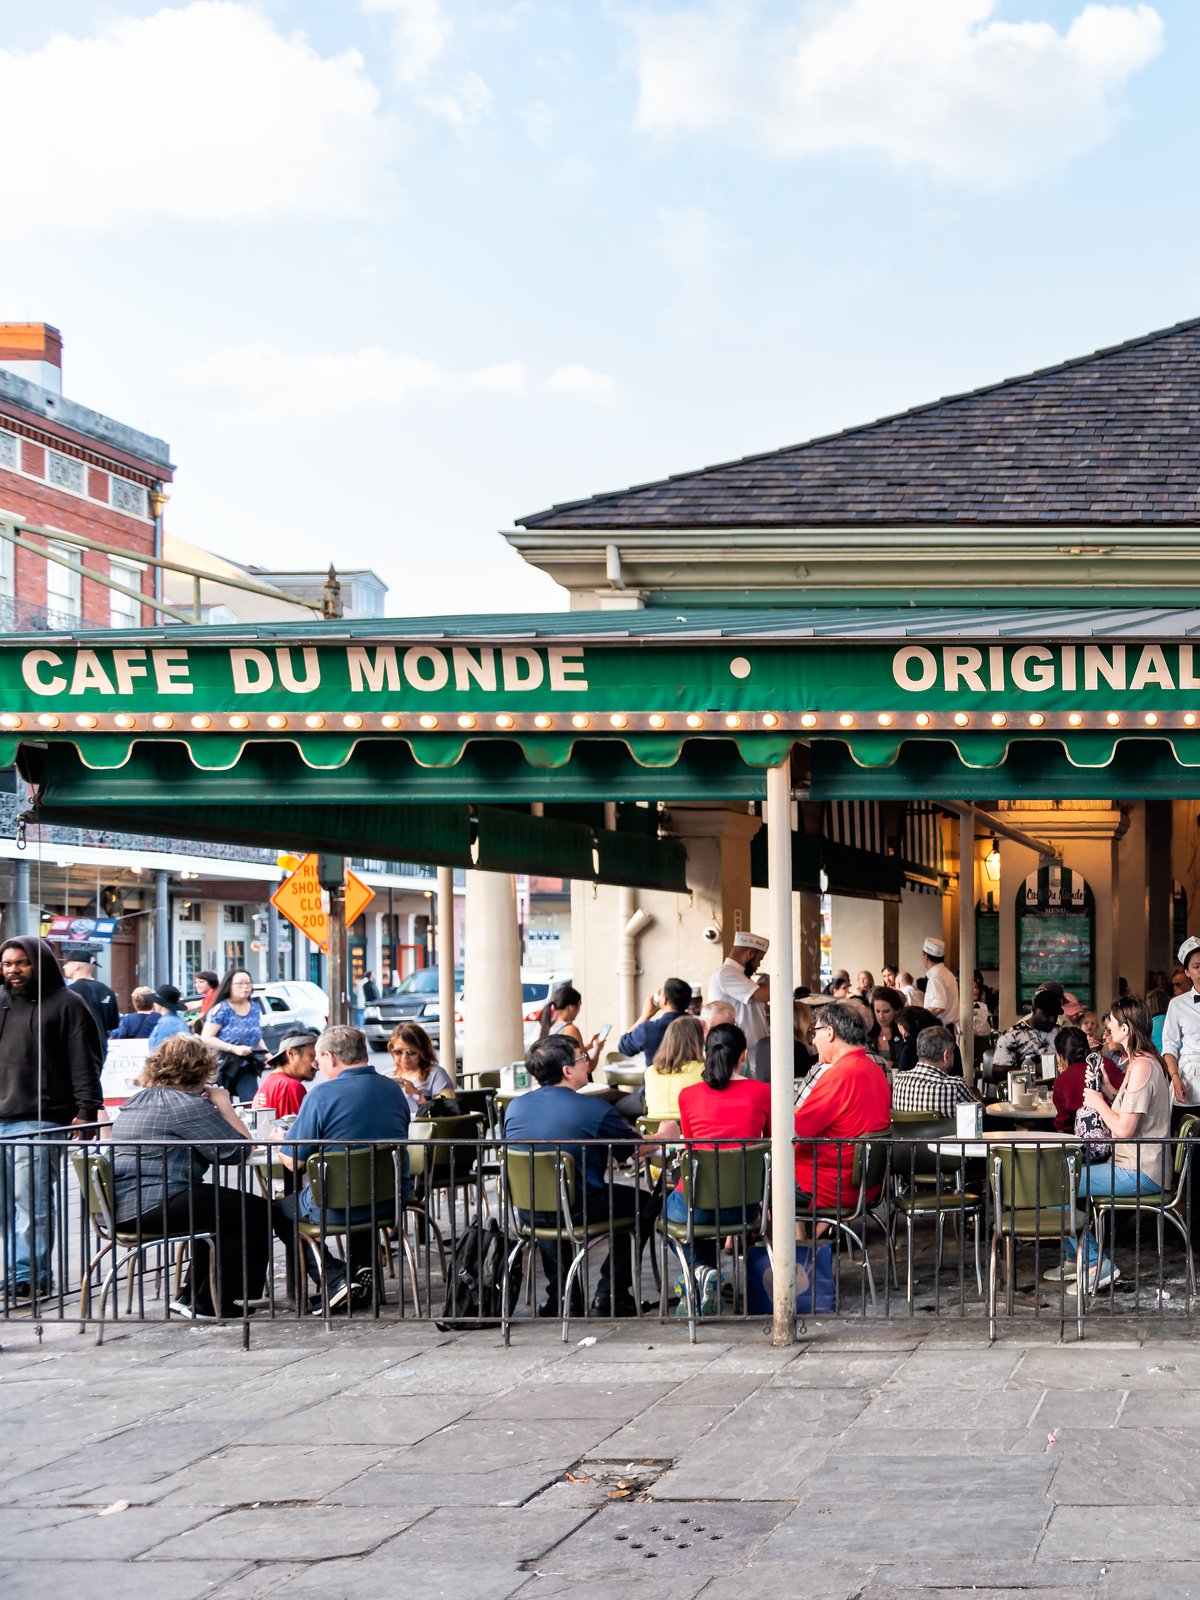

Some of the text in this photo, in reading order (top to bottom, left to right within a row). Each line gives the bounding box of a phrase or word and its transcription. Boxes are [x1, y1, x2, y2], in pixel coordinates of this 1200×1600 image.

[21, 648, 194, 696] CAFE
[229, 647, 321, 695] DU
[346, 646, 589, 692] MONDE
[301, 898, 322, 911] CLO
[302, 914, 325, 928] 200
